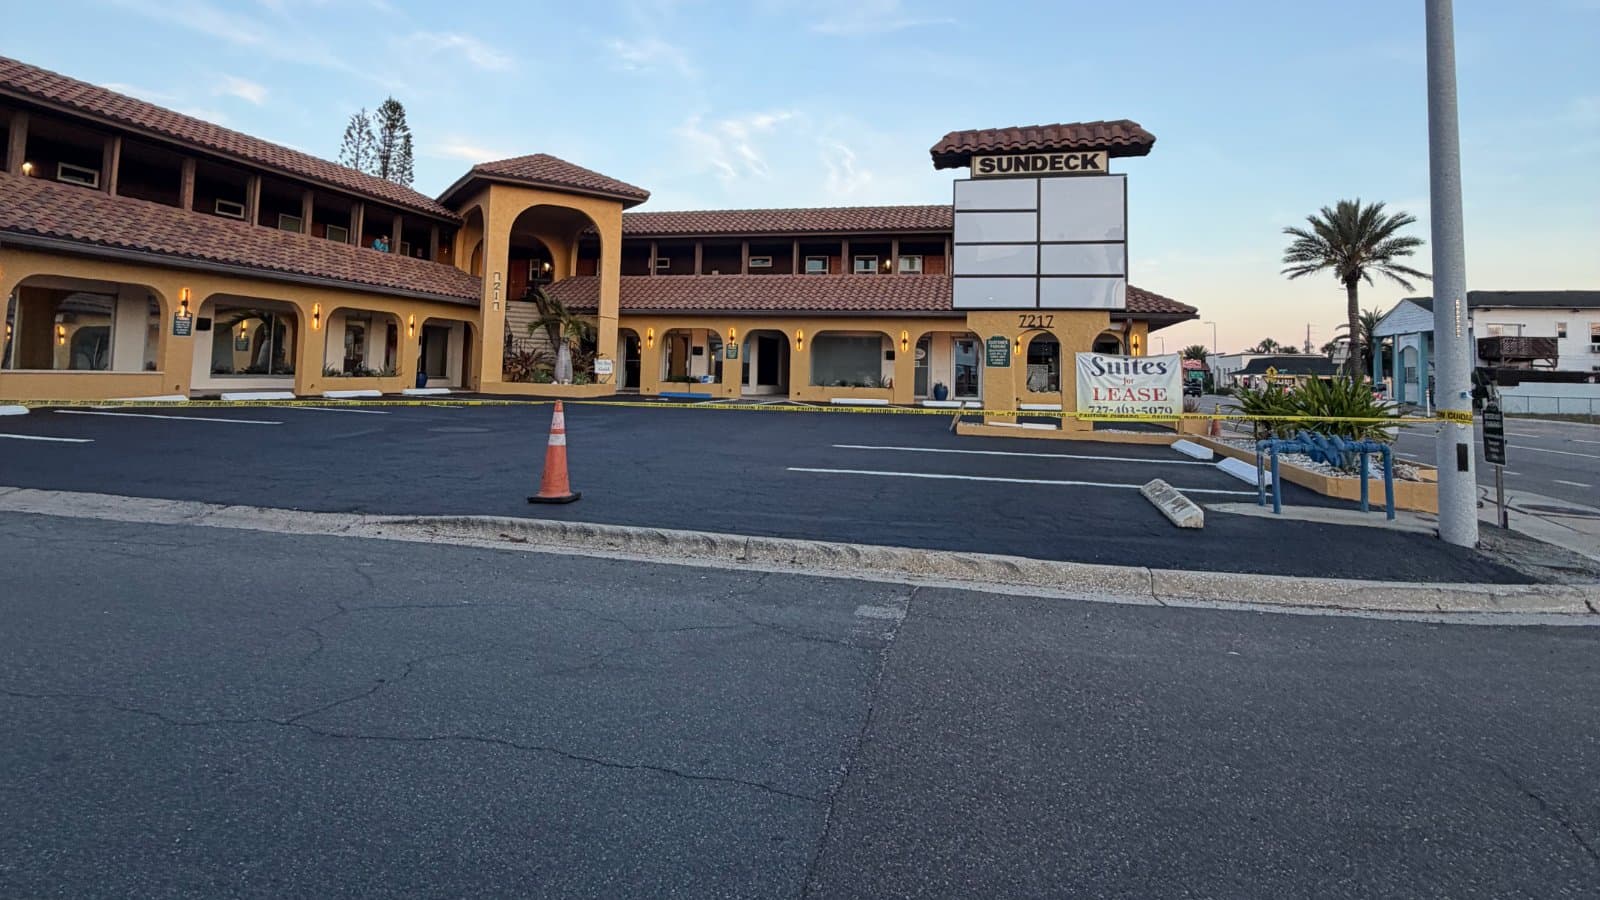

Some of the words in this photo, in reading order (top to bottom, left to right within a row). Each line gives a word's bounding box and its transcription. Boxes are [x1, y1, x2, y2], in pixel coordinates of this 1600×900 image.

[979, 154, 1100, 173] SUNDECK
[1018, 314, 1055, 328] 7217
[1091, 356, 1167, 376] Suites
[1093, 387, 1168, 402] LEASE
